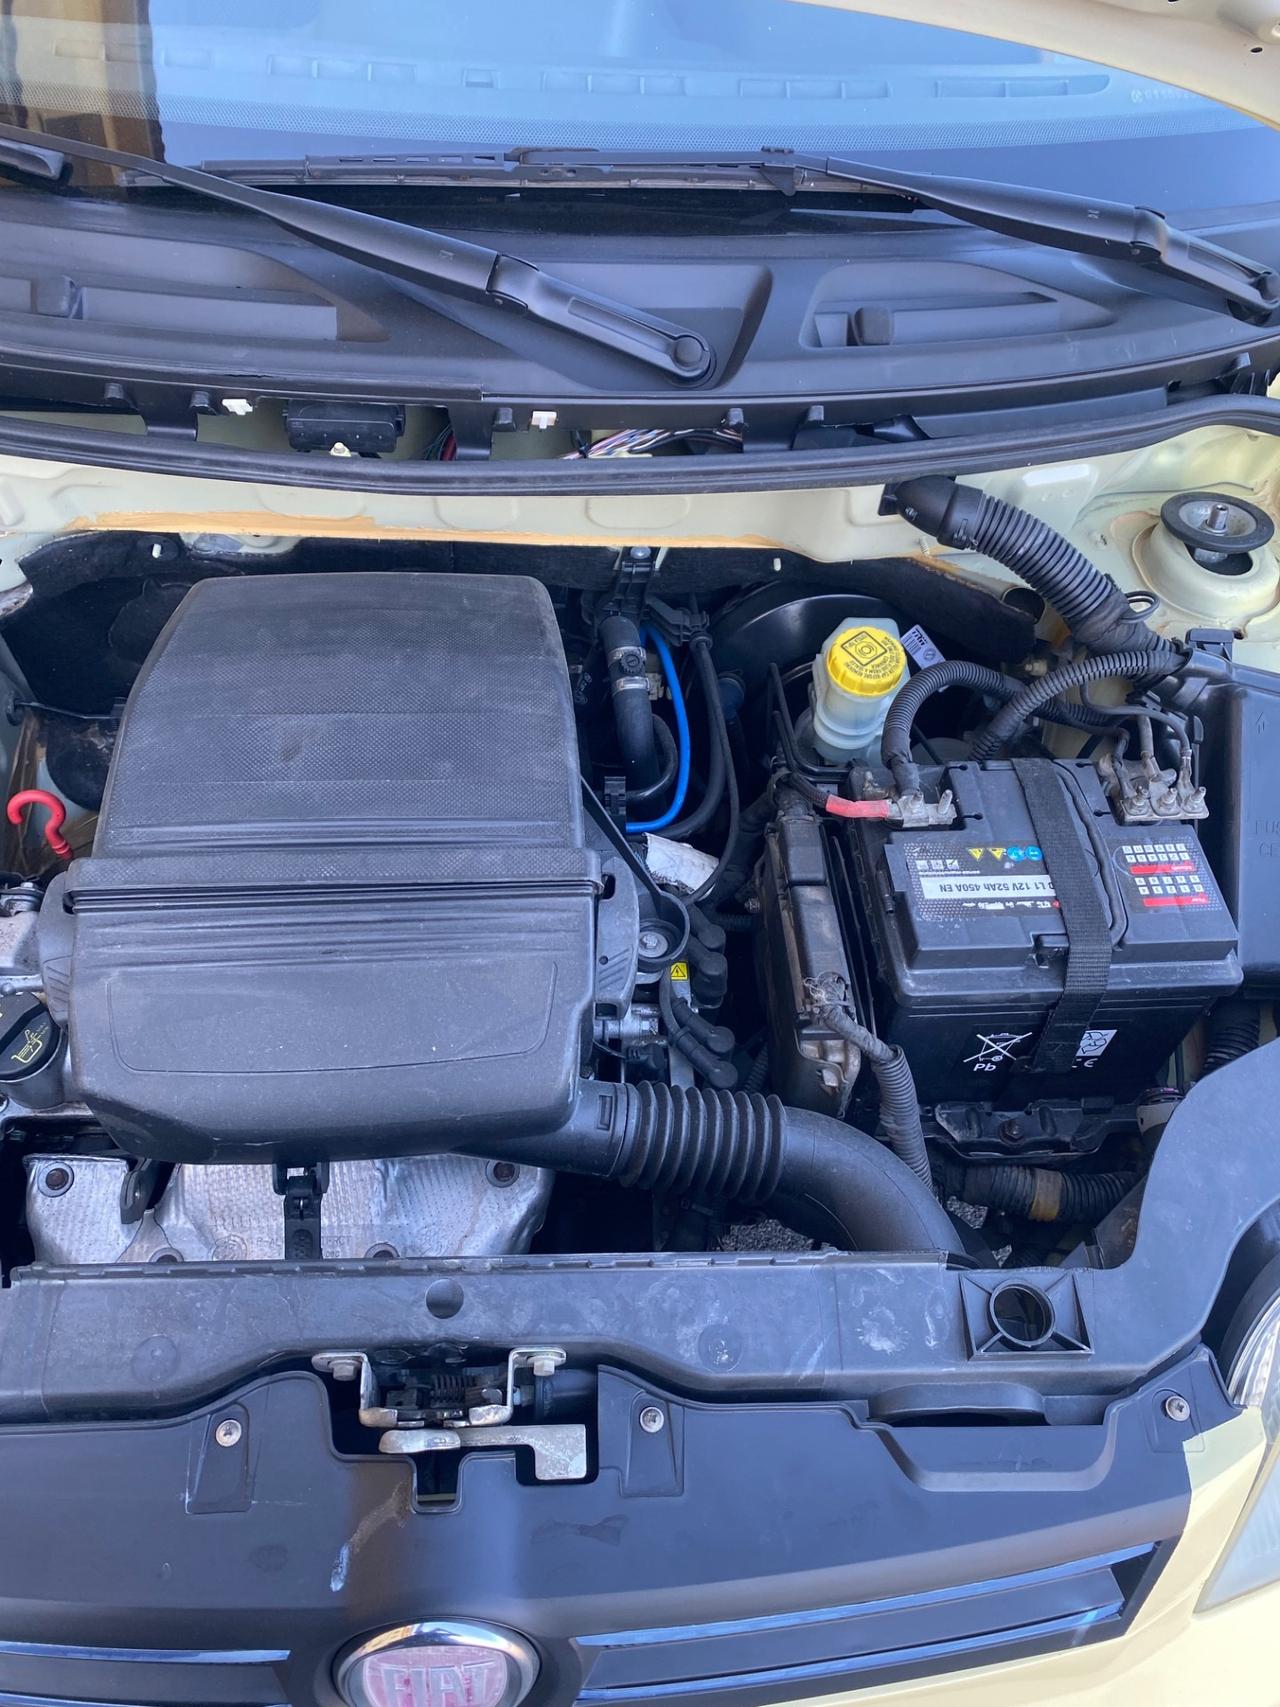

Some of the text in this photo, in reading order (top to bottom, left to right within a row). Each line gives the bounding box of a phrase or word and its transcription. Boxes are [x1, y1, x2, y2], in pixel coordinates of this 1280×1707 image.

[939, 883, 953, 892] EN
[956, 883, 980, 892] 450A
[984, 882, 1010, 891] 52Ah
[1012, 882, 1030, 891] 12V
[1033, 882, 1046, 890] L1
[973, 1062, 997, 1072] Pb
